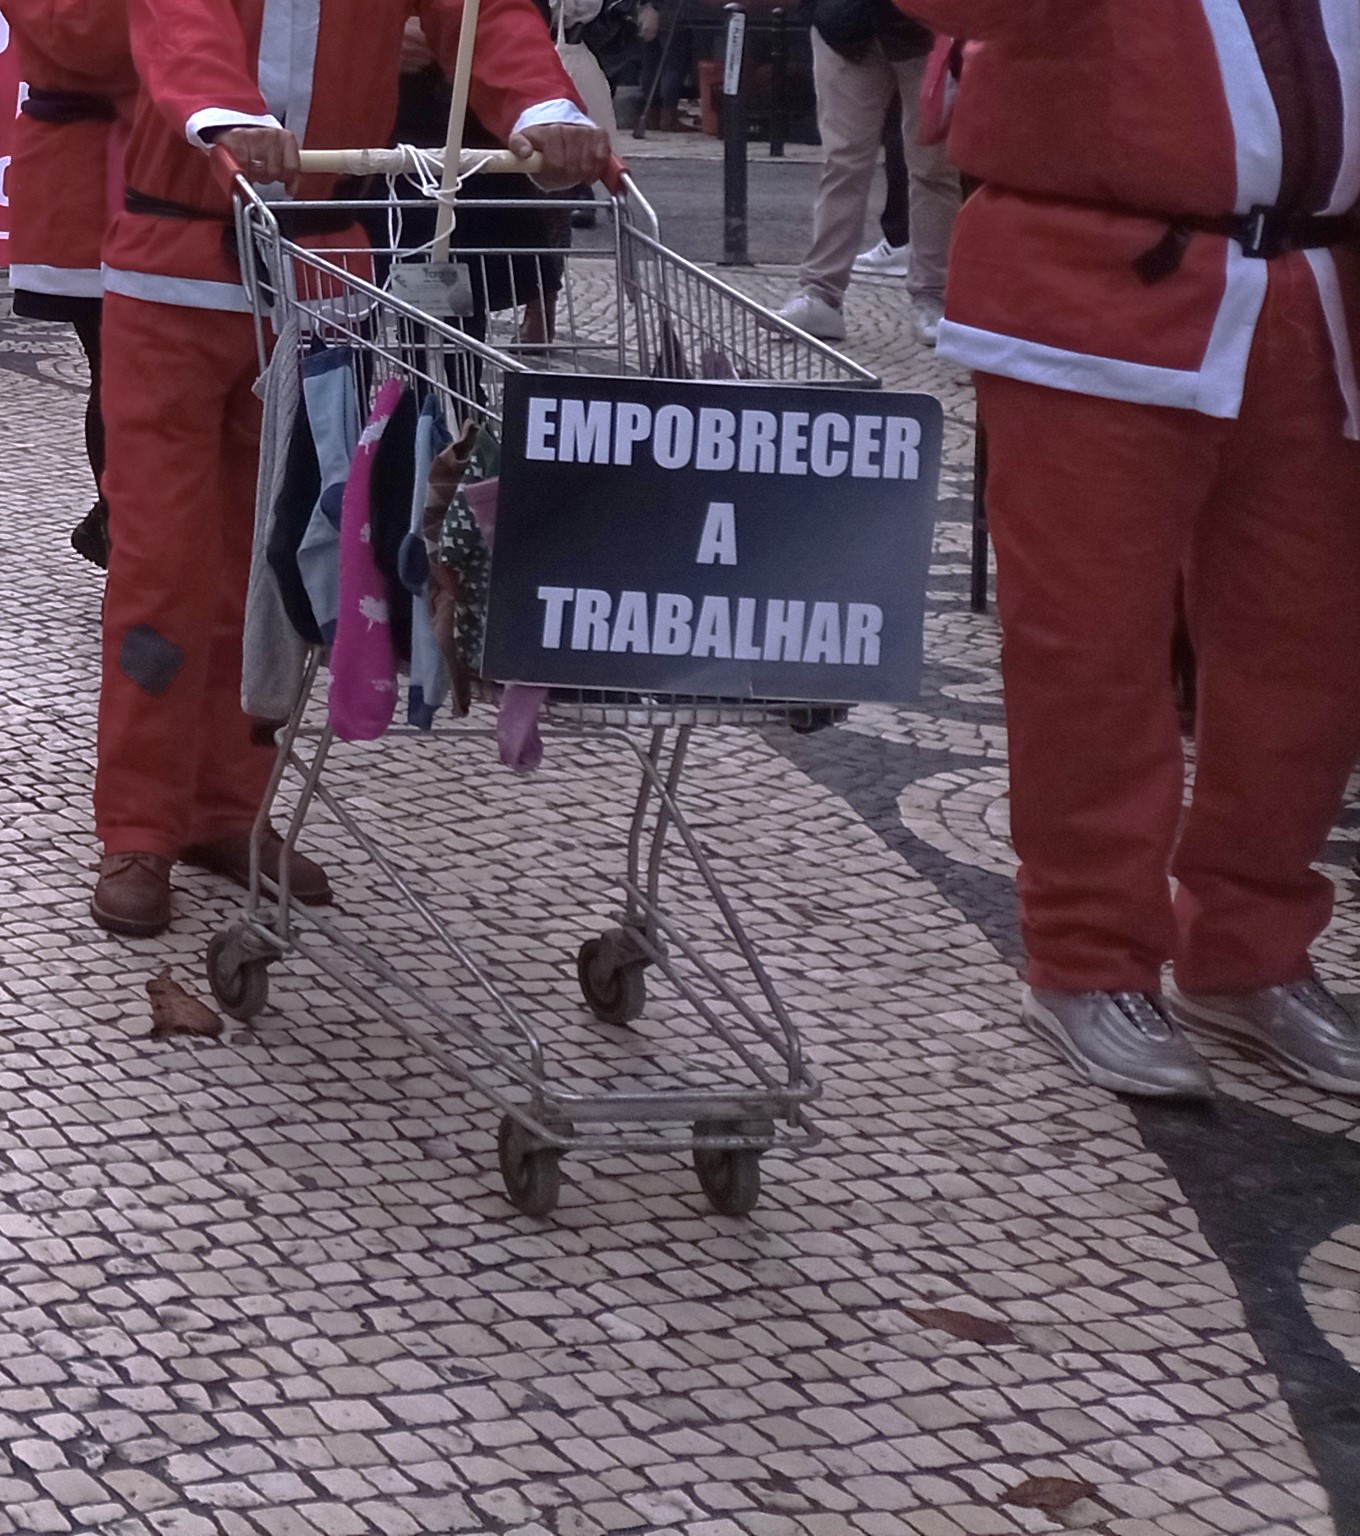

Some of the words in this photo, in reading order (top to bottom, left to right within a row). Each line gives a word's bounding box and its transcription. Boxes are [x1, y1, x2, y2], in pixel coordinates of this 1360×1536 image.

[525, 396, 922, 480] EMPOBRECER
[696, 501, 738, 565] A
[536, 585, 885, 666] TRABALHAR
